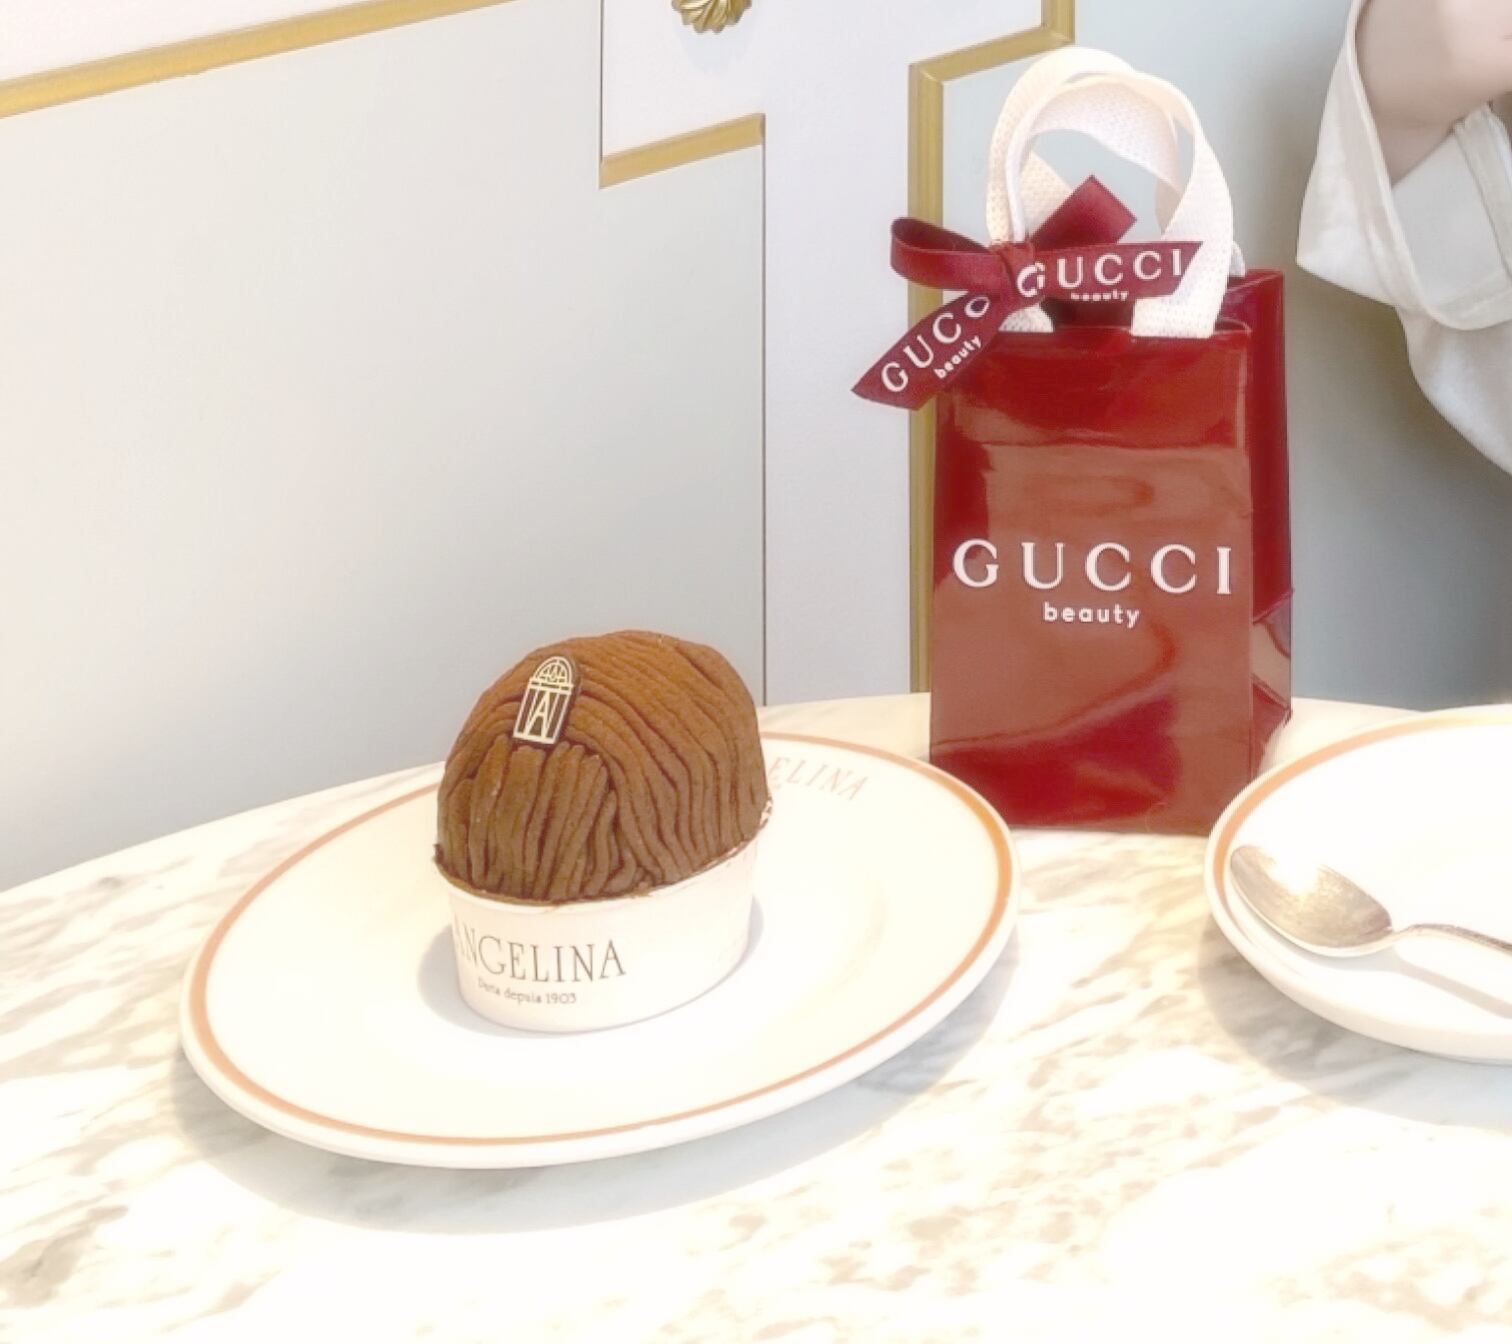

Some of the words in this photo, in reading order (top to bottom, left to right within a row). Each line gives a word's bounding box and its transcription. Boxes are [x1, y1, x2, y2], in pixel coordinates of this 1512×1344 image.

[1016, 248, 1182, 298] GUCCI
[881, 296, 991, 392] GUCC
[934, 336, 982, 379] beauty
[952, 538, 1232, 595] GUCCI
[1043, 602, 1140, 629] beauty
[768, 756, 869, 801] ELINA
[545, 992, 577, 1005] 1903
